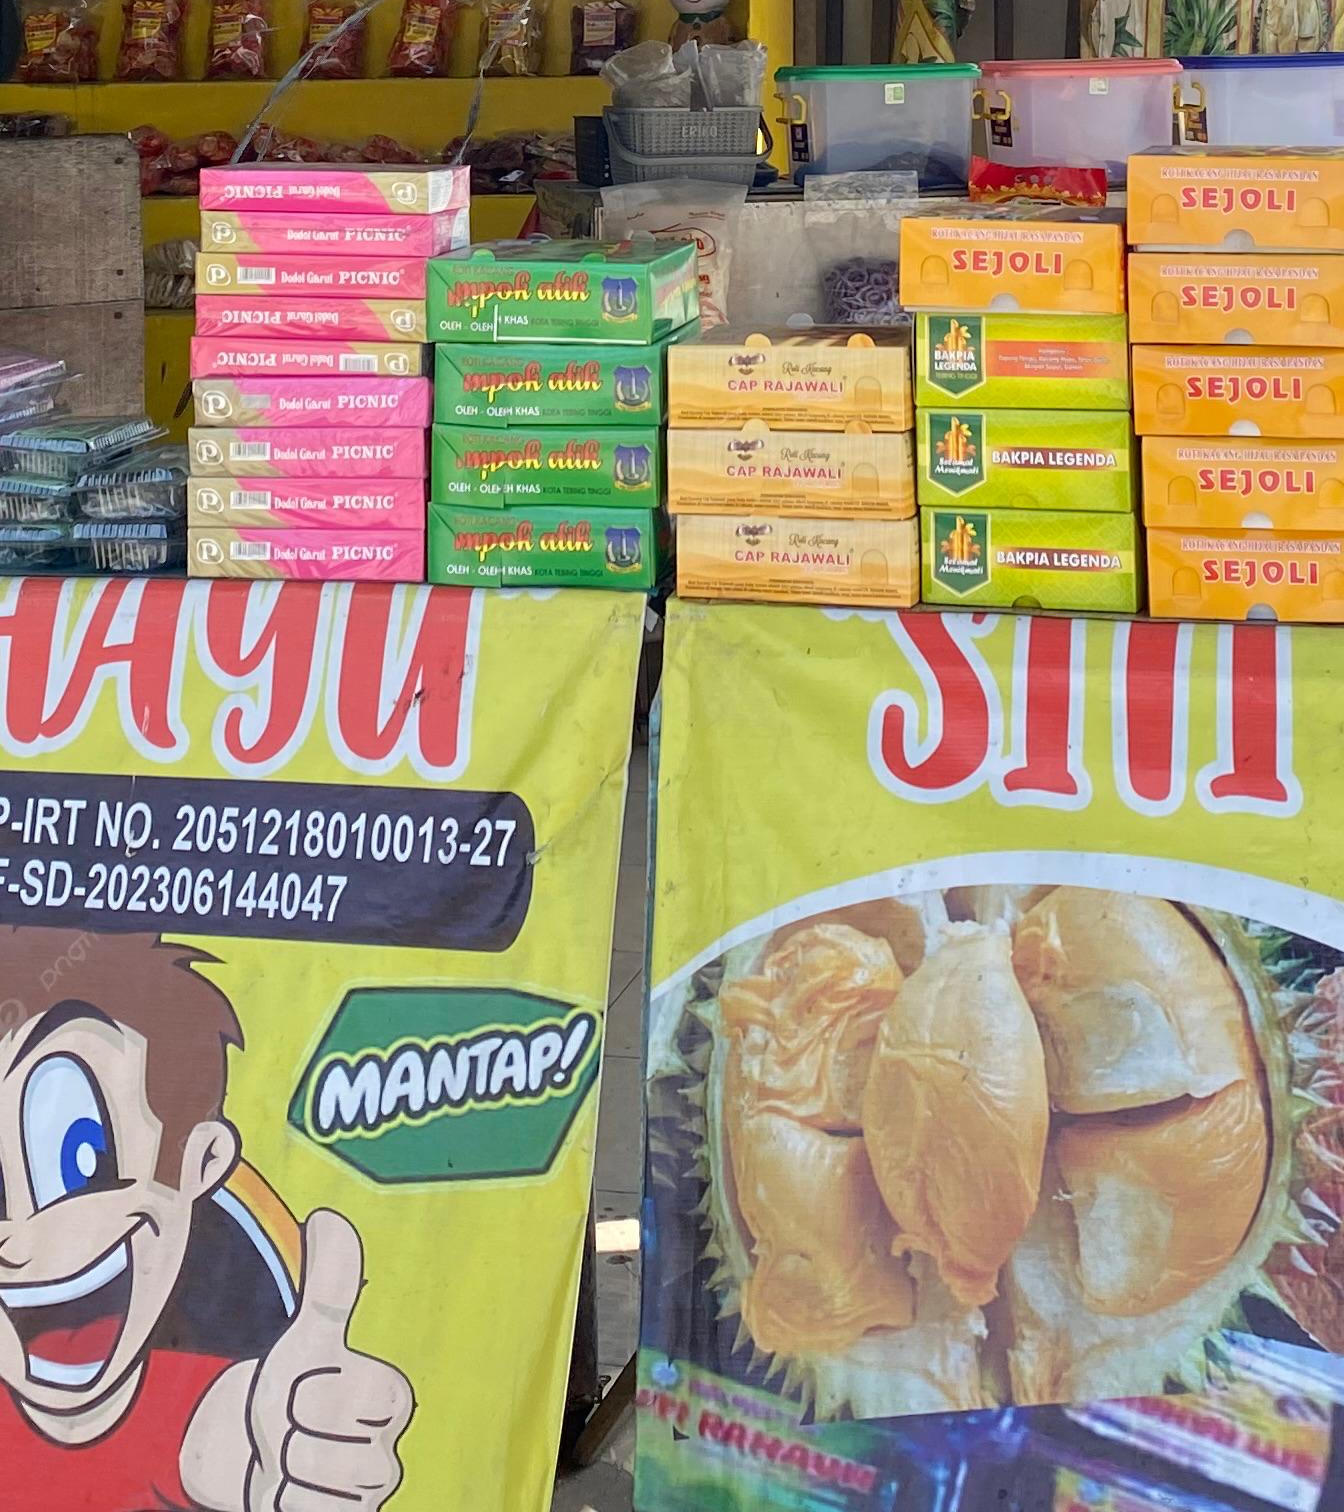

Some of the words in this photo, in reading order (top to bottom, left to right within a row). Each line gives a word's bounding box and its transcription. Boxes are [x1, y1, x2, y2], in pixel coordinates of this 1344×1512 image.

[1181, 185, 1296, 213] SEJOLI
[953, 250, 1062, 275] SEJOLI
[338, 271, 400, 286] PICNIC
[1182, 284, 1296, 313] SEJOLI
[728, 379, 758, 392] CAP
[764, 379, 844, 394] RAJAWALI
[1187, 375, 1302, 402] SEJOLI
[337, 394, 399, 409] PICNIC
[331, 445, 394, 460] PICNIC
[992, 449, 1045, 466] BAKPIA
[1048, 451, 1117, 467] LEGENDA
[726, 465, 757, 478] CAP
[762, 466, 842, 480] RAJAWALI
[1198, 467, 1314, 496] SEJOLI
[332, 495, 395, 510] PICNIC
[331, 545, 394, 560] PICNIC
[734, 549, 765, 562] CAP
[770, 550, 851, 566] RAJAWALI
[997, 550, 1051, 567] BAKPIA
[1053, 552, 1122, 569] LEGENDA
[1202, 558, 1319, 586] SEJOLI
[95, 801, 163, 854] NO.
[175, 803, 518, 868] 2051218010013-27
[315, 1016, 596, 1136] MANTAP!
